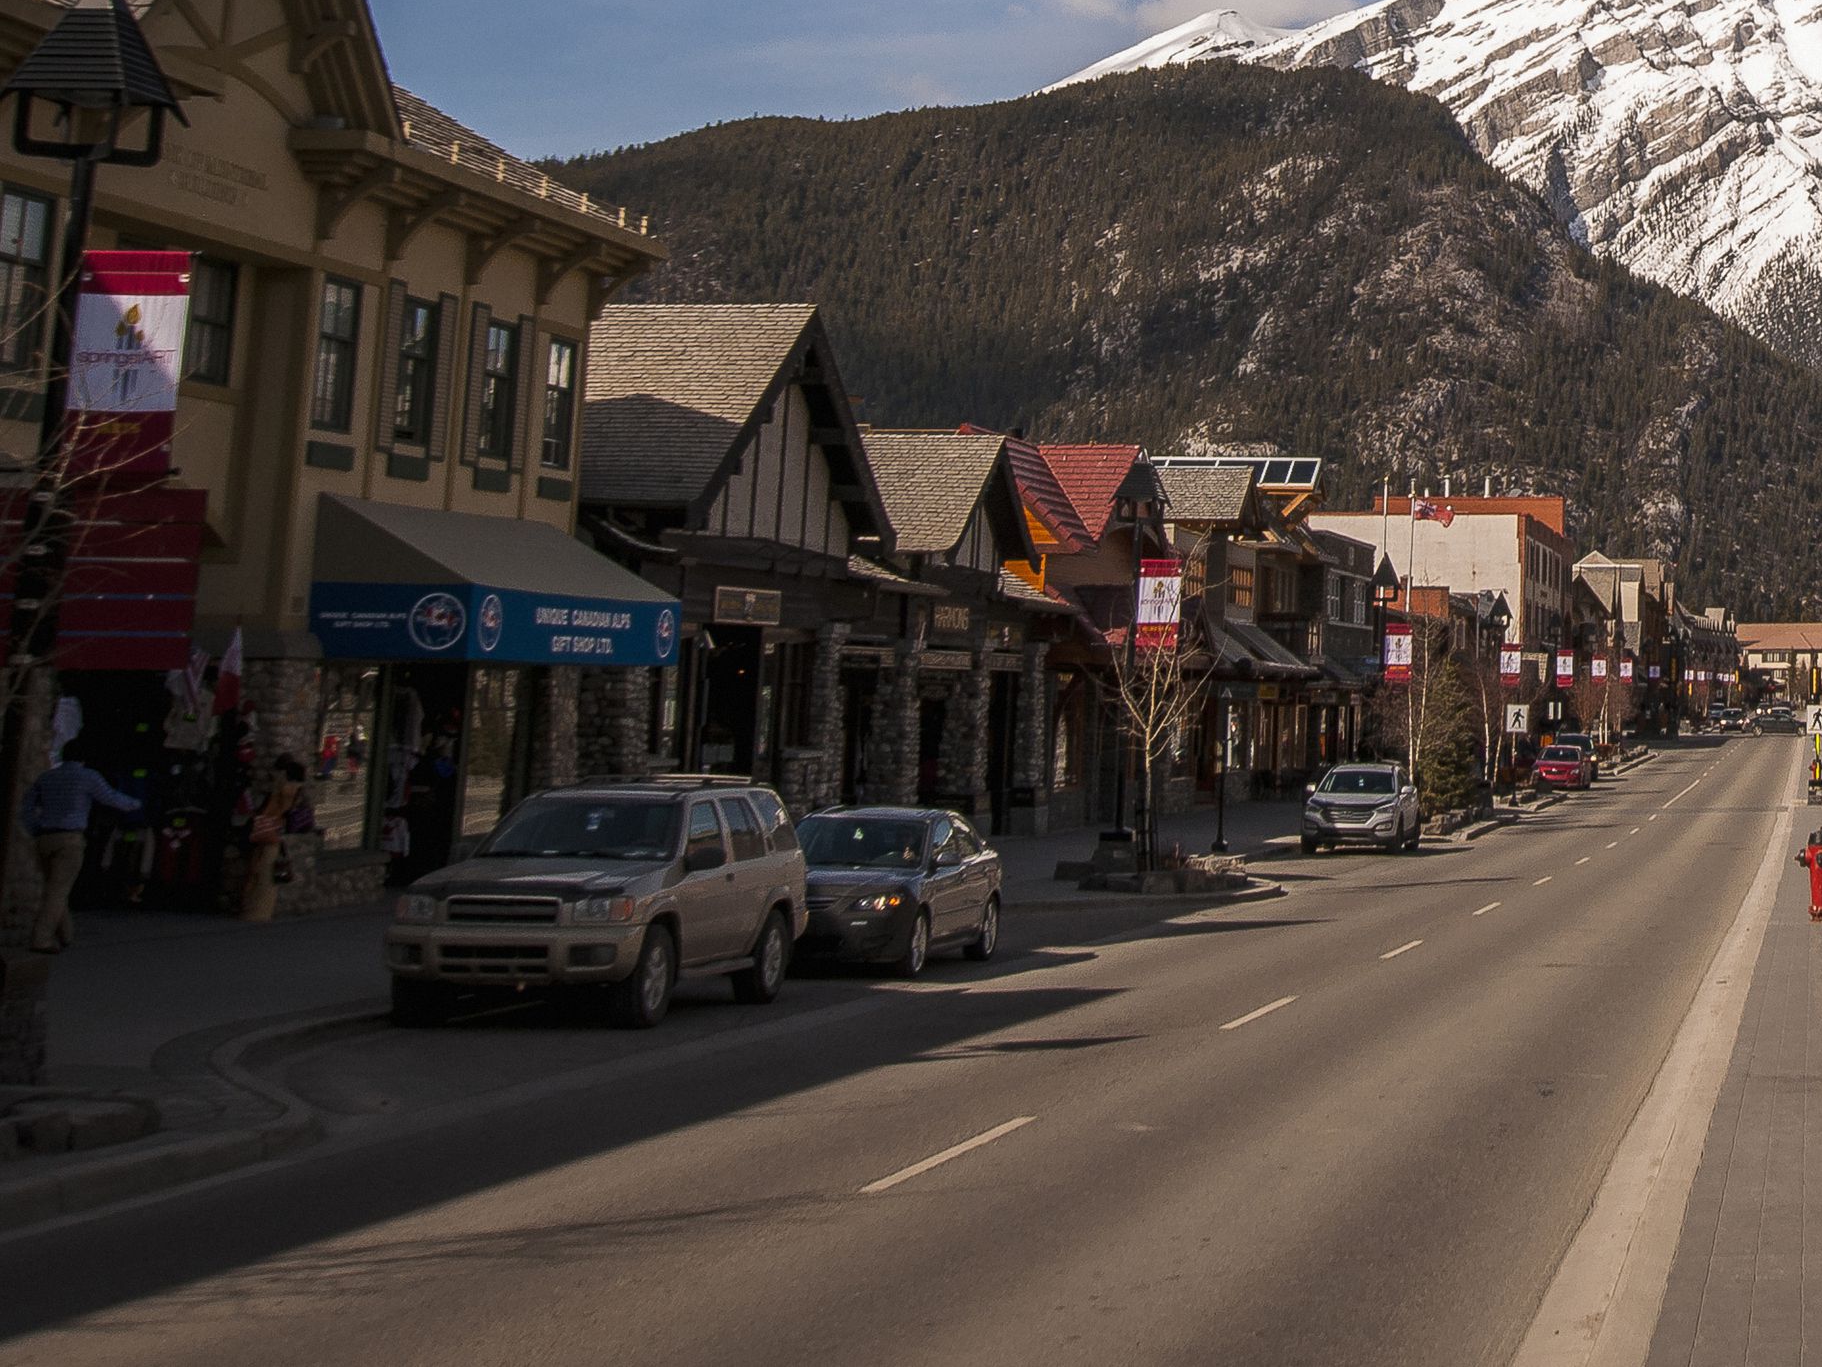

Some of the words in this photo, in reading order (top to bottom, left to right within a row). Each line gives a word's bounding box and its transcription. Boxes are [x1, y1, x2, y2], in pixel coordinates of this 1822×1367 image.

[536, 607, 569, 625] UNIQUE
[572, 609, 611, 628] CANADIAN
[611, 612, 632, 629] ALPS
[551, 635, 572, 653] GIFT
[572, 635, 596, 653] SHOP
